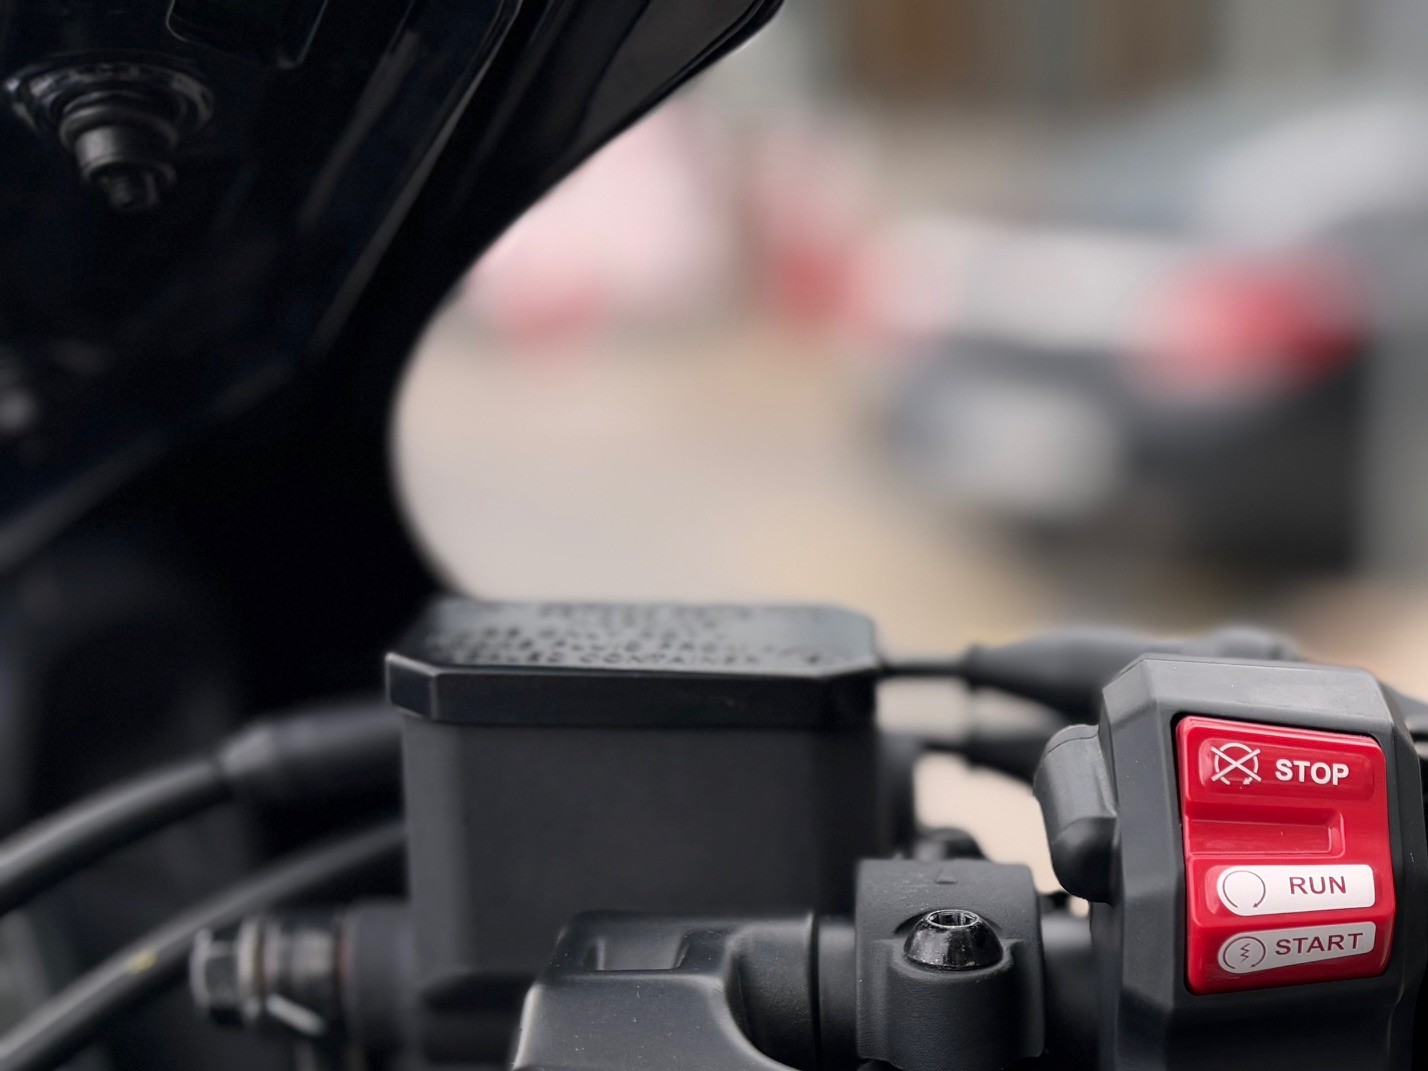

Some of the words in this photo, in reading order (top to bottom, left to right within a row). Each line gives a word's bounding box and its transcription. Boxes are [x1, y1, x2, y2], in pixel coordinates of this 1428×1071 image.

[1274, 758, 1350, 786] STOP
[1288, 875, 1348, 895] RUN
[1274, 932, 1364, 956] START
